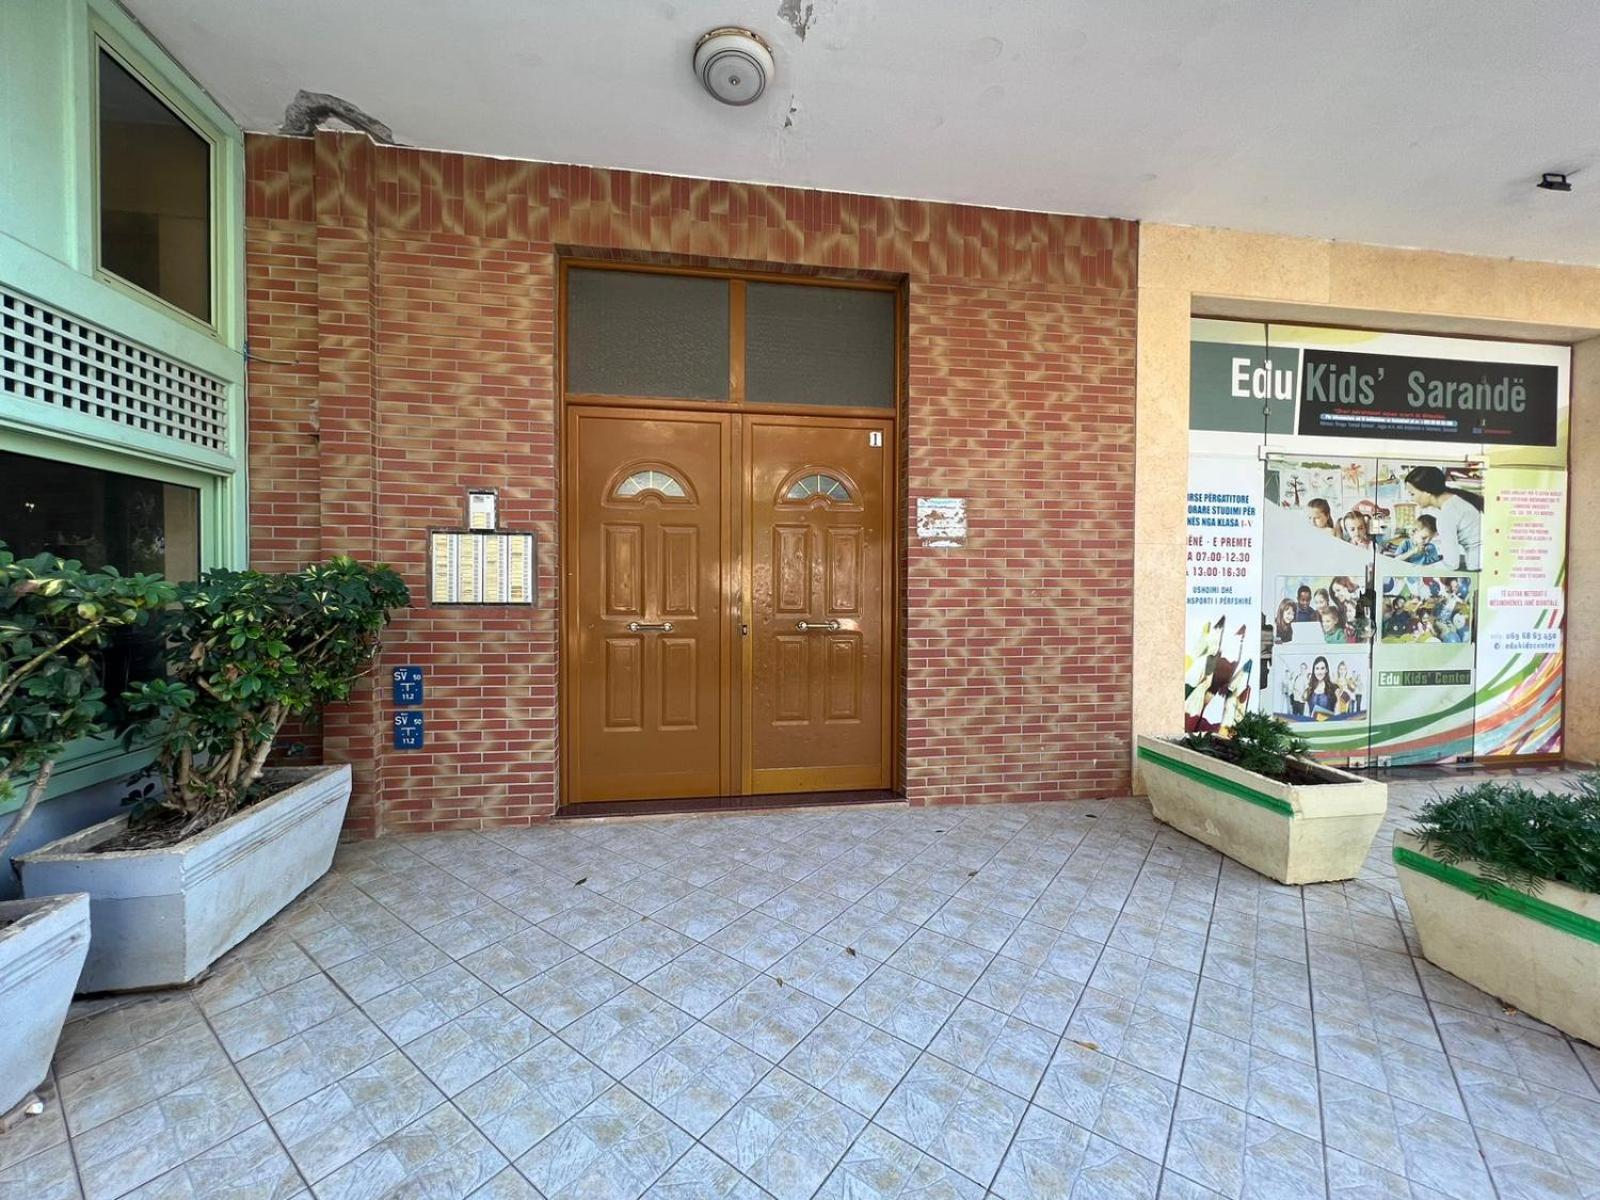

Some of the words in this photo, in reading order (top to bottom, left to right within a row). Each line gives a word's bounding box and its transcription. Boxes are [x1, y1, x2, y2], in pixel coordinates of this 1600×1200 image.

[1231, 357, 1293, 400] Edu
[1407, 370, 1526, 413] Sarandë
[1212, 505, 1241, 515] STUDIMI
[1201, 518, 1216, 526] NGA
[1217, 518, 1240, 527] KLASA
[1213, 537, 1218, 547] E
[1220, 537, 1252, 548] PREMTE
[1196, 551, 1250, 562] 07:00-12:30
[1193, 567, 1247, 577] 13:00-16:30
[394, 671, 408, 681] SV
[1380, 672, 1400, 686] Edu
[1435, 671, 1470, 684] Center
[395, 716, 408, 725] SV
